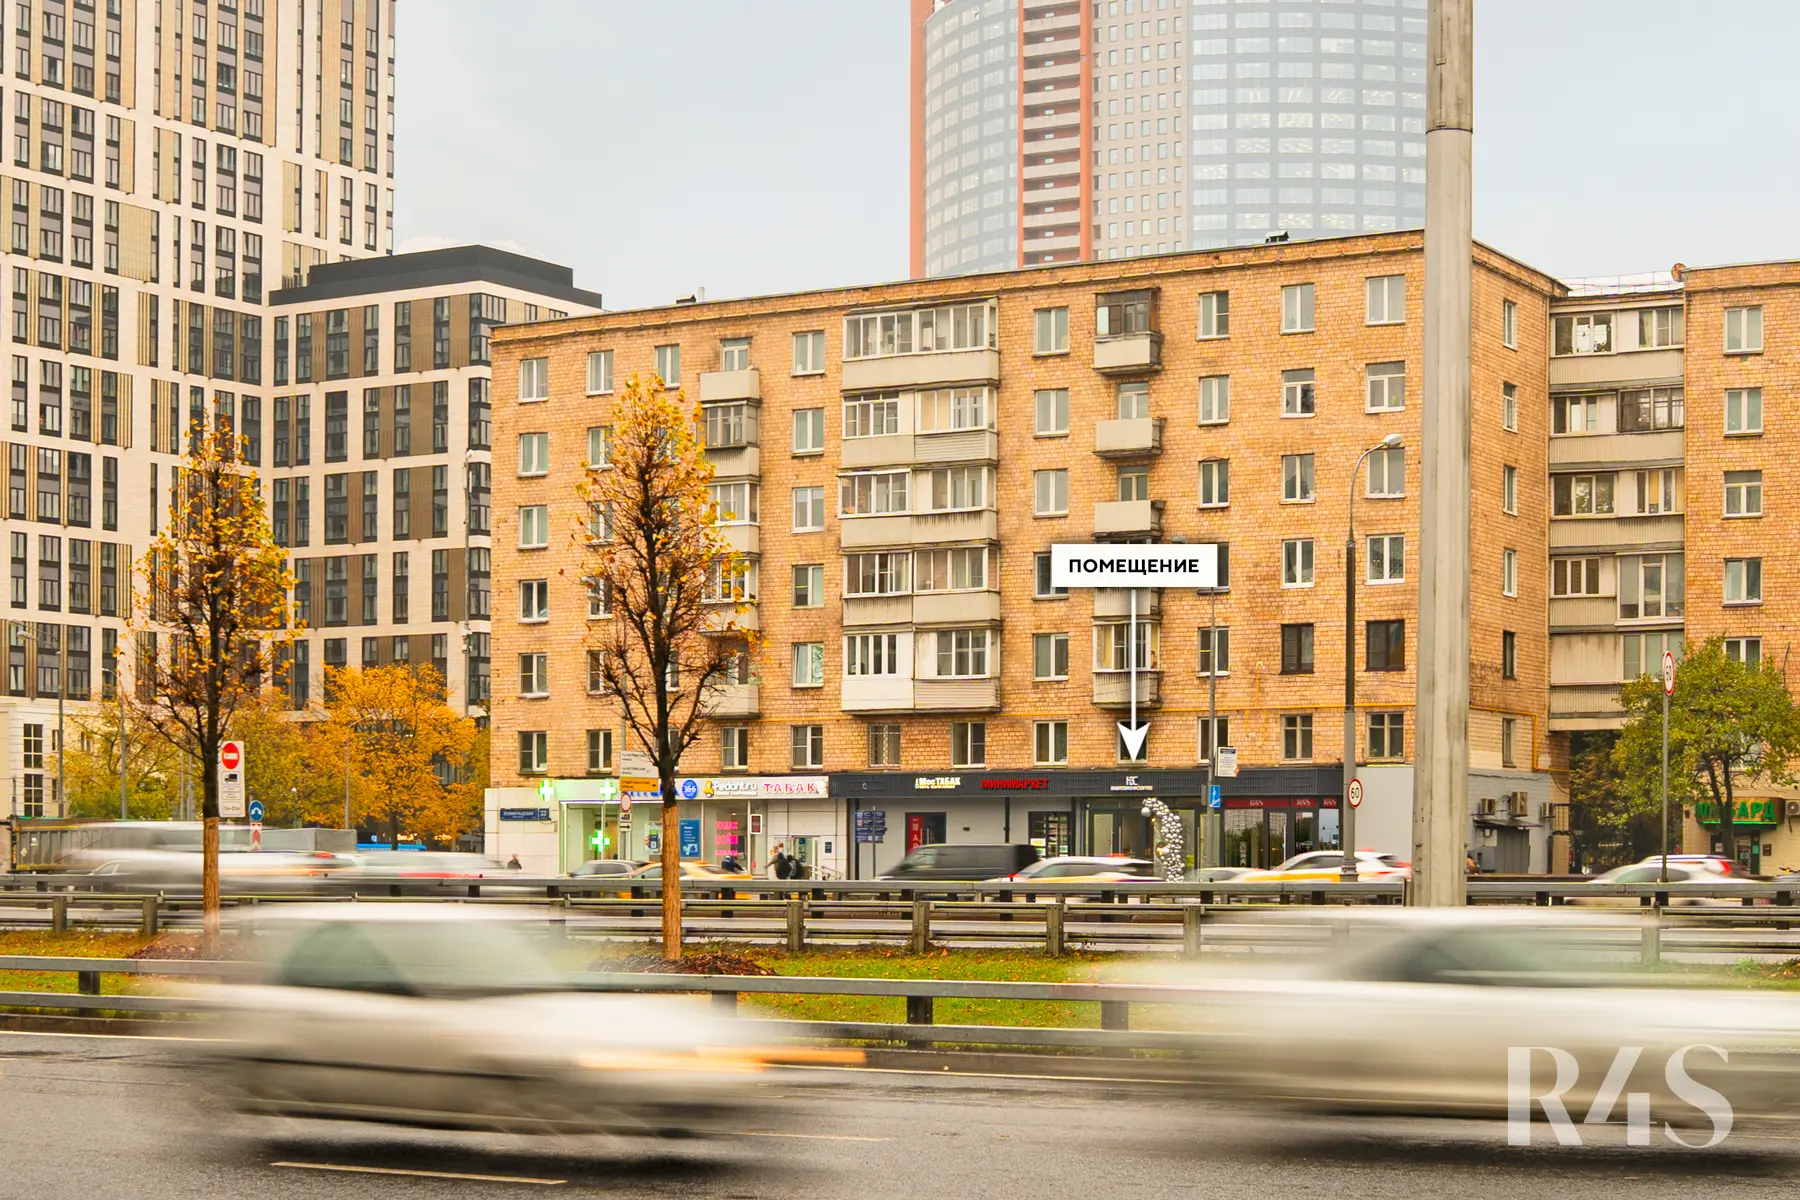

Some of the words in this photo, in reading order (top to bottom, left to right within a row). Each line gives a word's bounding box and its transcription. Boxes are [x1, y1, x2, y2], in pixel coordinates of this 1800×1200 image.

[764, 783, 816, 794] ТАБАК
[981, 778, 1048, 789] МИНИМАРКЕТ
[1351, 787, 1360, 799] 60
